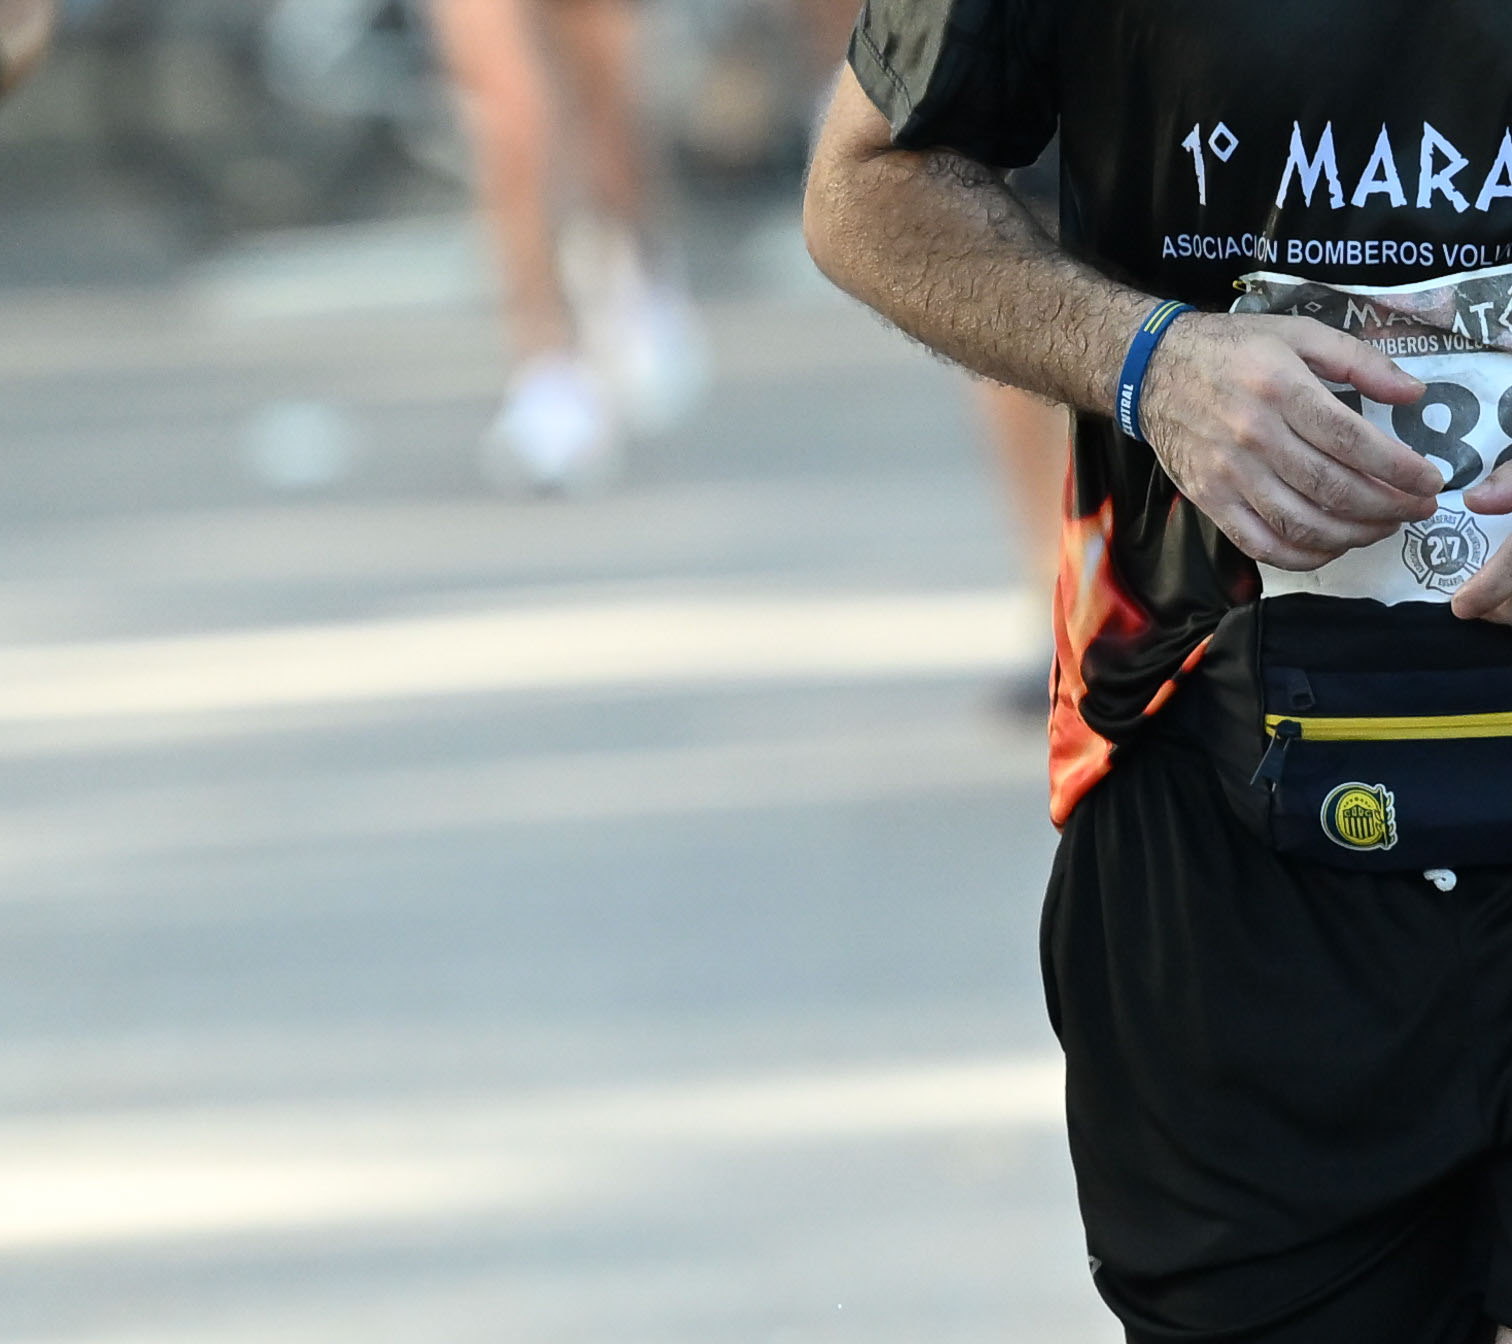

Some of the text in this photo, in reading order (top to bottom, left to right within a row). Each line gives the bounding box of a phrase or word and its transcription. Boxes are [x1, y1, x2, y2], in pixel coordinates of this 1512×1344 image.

[1161, 230, 1278, 264] ASOCIACIÓN
[1287, 240, 1434, 267] BOMBEROS
[1363, 334, 1440, 357] MBEROS
[1426, 535, 1462, 566] 27
